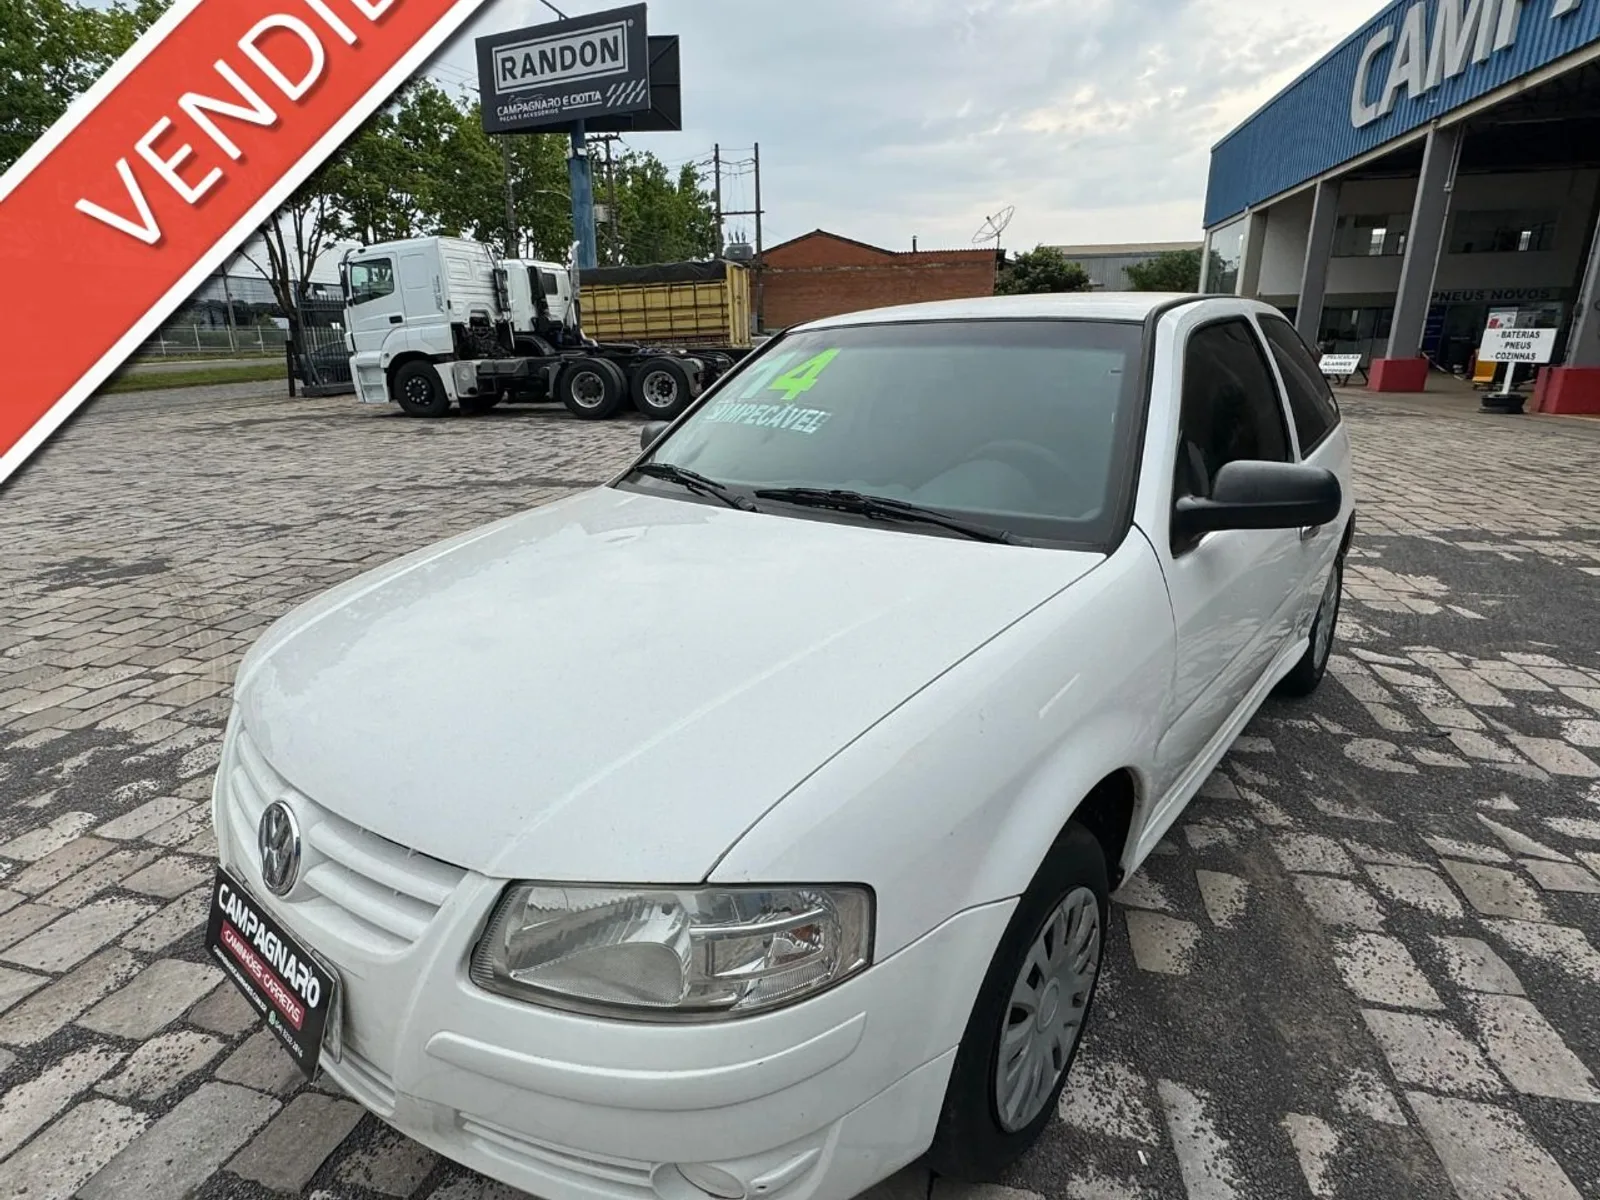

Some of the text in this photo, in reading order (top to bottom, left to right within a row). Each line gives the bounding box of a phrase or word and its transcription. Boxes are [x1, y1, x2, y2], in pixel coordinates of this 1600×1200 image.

[500, 35, 620, 82] RANDON
[496, 97, 561, 117] CAMPAGNARO
[1431, 287, 1551, 302] PNEUS NOVOS
[1504, 341, 1532, 350] PNEUS
[218, 883, 321, 1009] CAMPAGNARO
[263, 974, 301, 1023] CARRETAS
